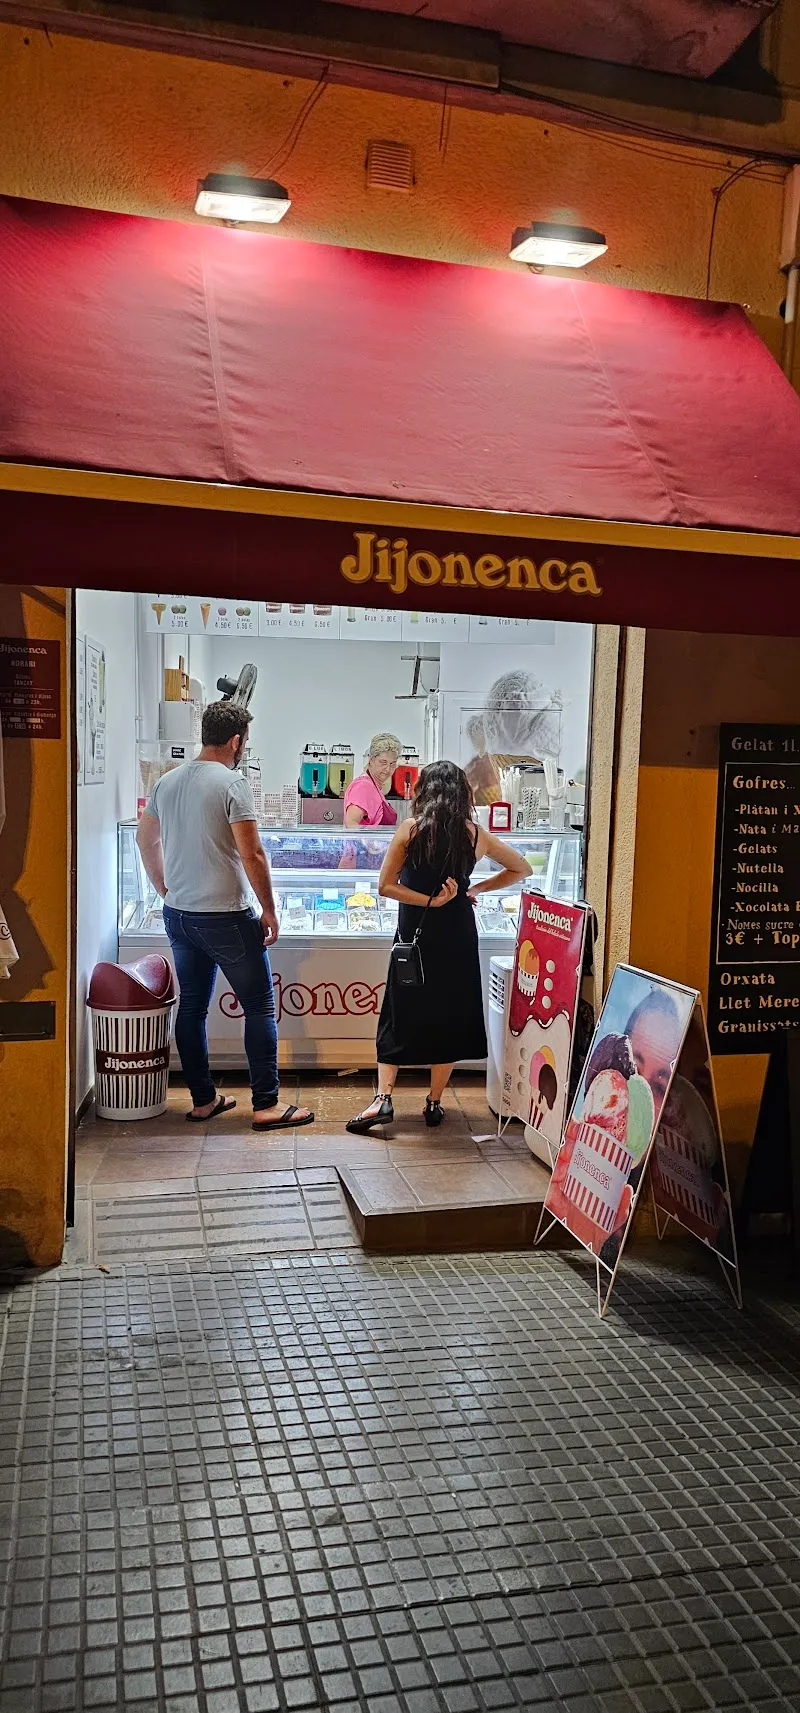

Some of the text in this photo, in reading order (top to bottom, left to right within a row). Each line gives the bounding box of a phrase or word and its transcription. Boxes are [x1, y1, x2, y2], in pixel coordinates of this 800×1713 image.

[340, 531, 603, 597] Jijonenca
[10, 659, 36, 668] HORARI
[731, 737, 774, 751] Gelat
[784, 804, 788, 815] i
[527, 901, 573, 933] Jijonenca
[764, 921, 795, 931] sucre
[771, 930, 800, 949] Top
[720, 972, 776, 986] Orxata
[719, 996, 752, 1010] Llet
[104, 1055, 166, 1072] Jijonenca
